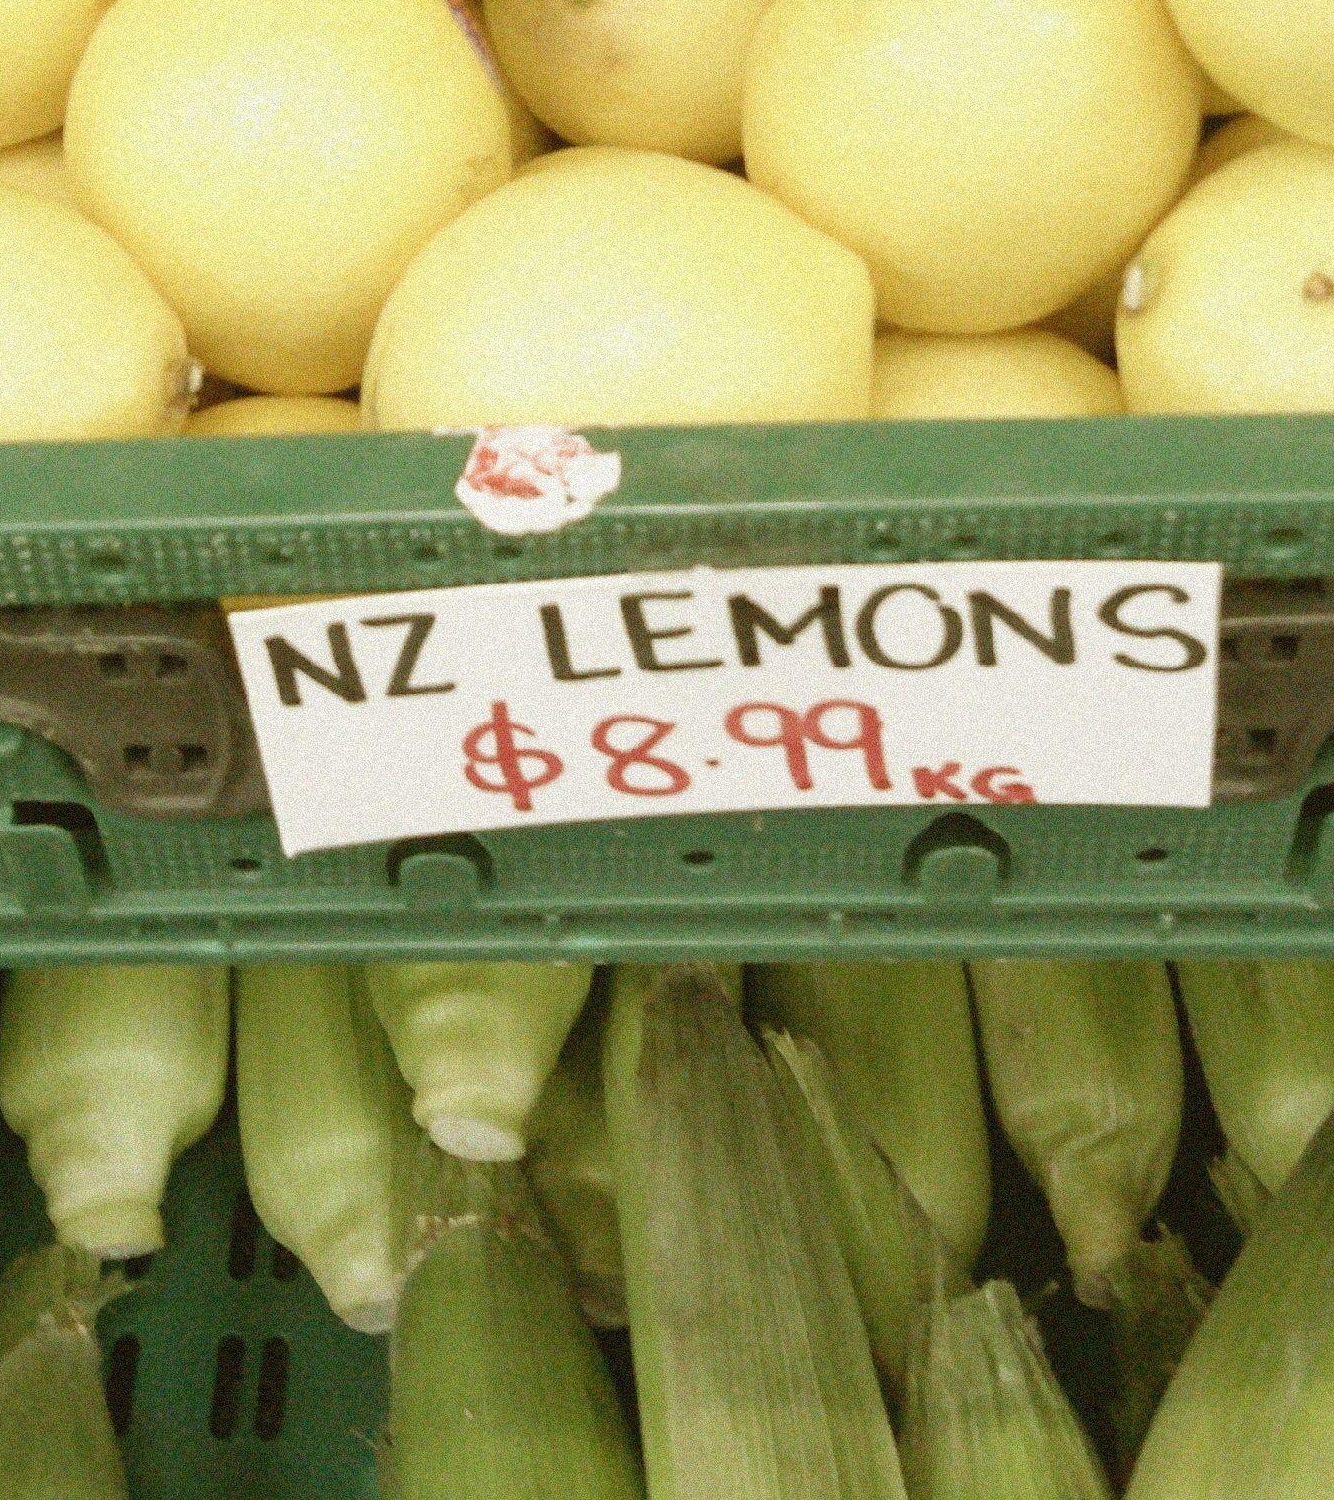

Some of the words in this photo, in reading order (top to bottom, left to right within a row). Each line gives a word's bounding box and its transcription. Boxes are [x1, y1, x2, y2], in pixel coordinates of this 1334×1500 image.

[265, 613, 454, 706] NZ
[539, 584, 1208, 681] LEMONS
[463, 700, 891, 811] $8.99
